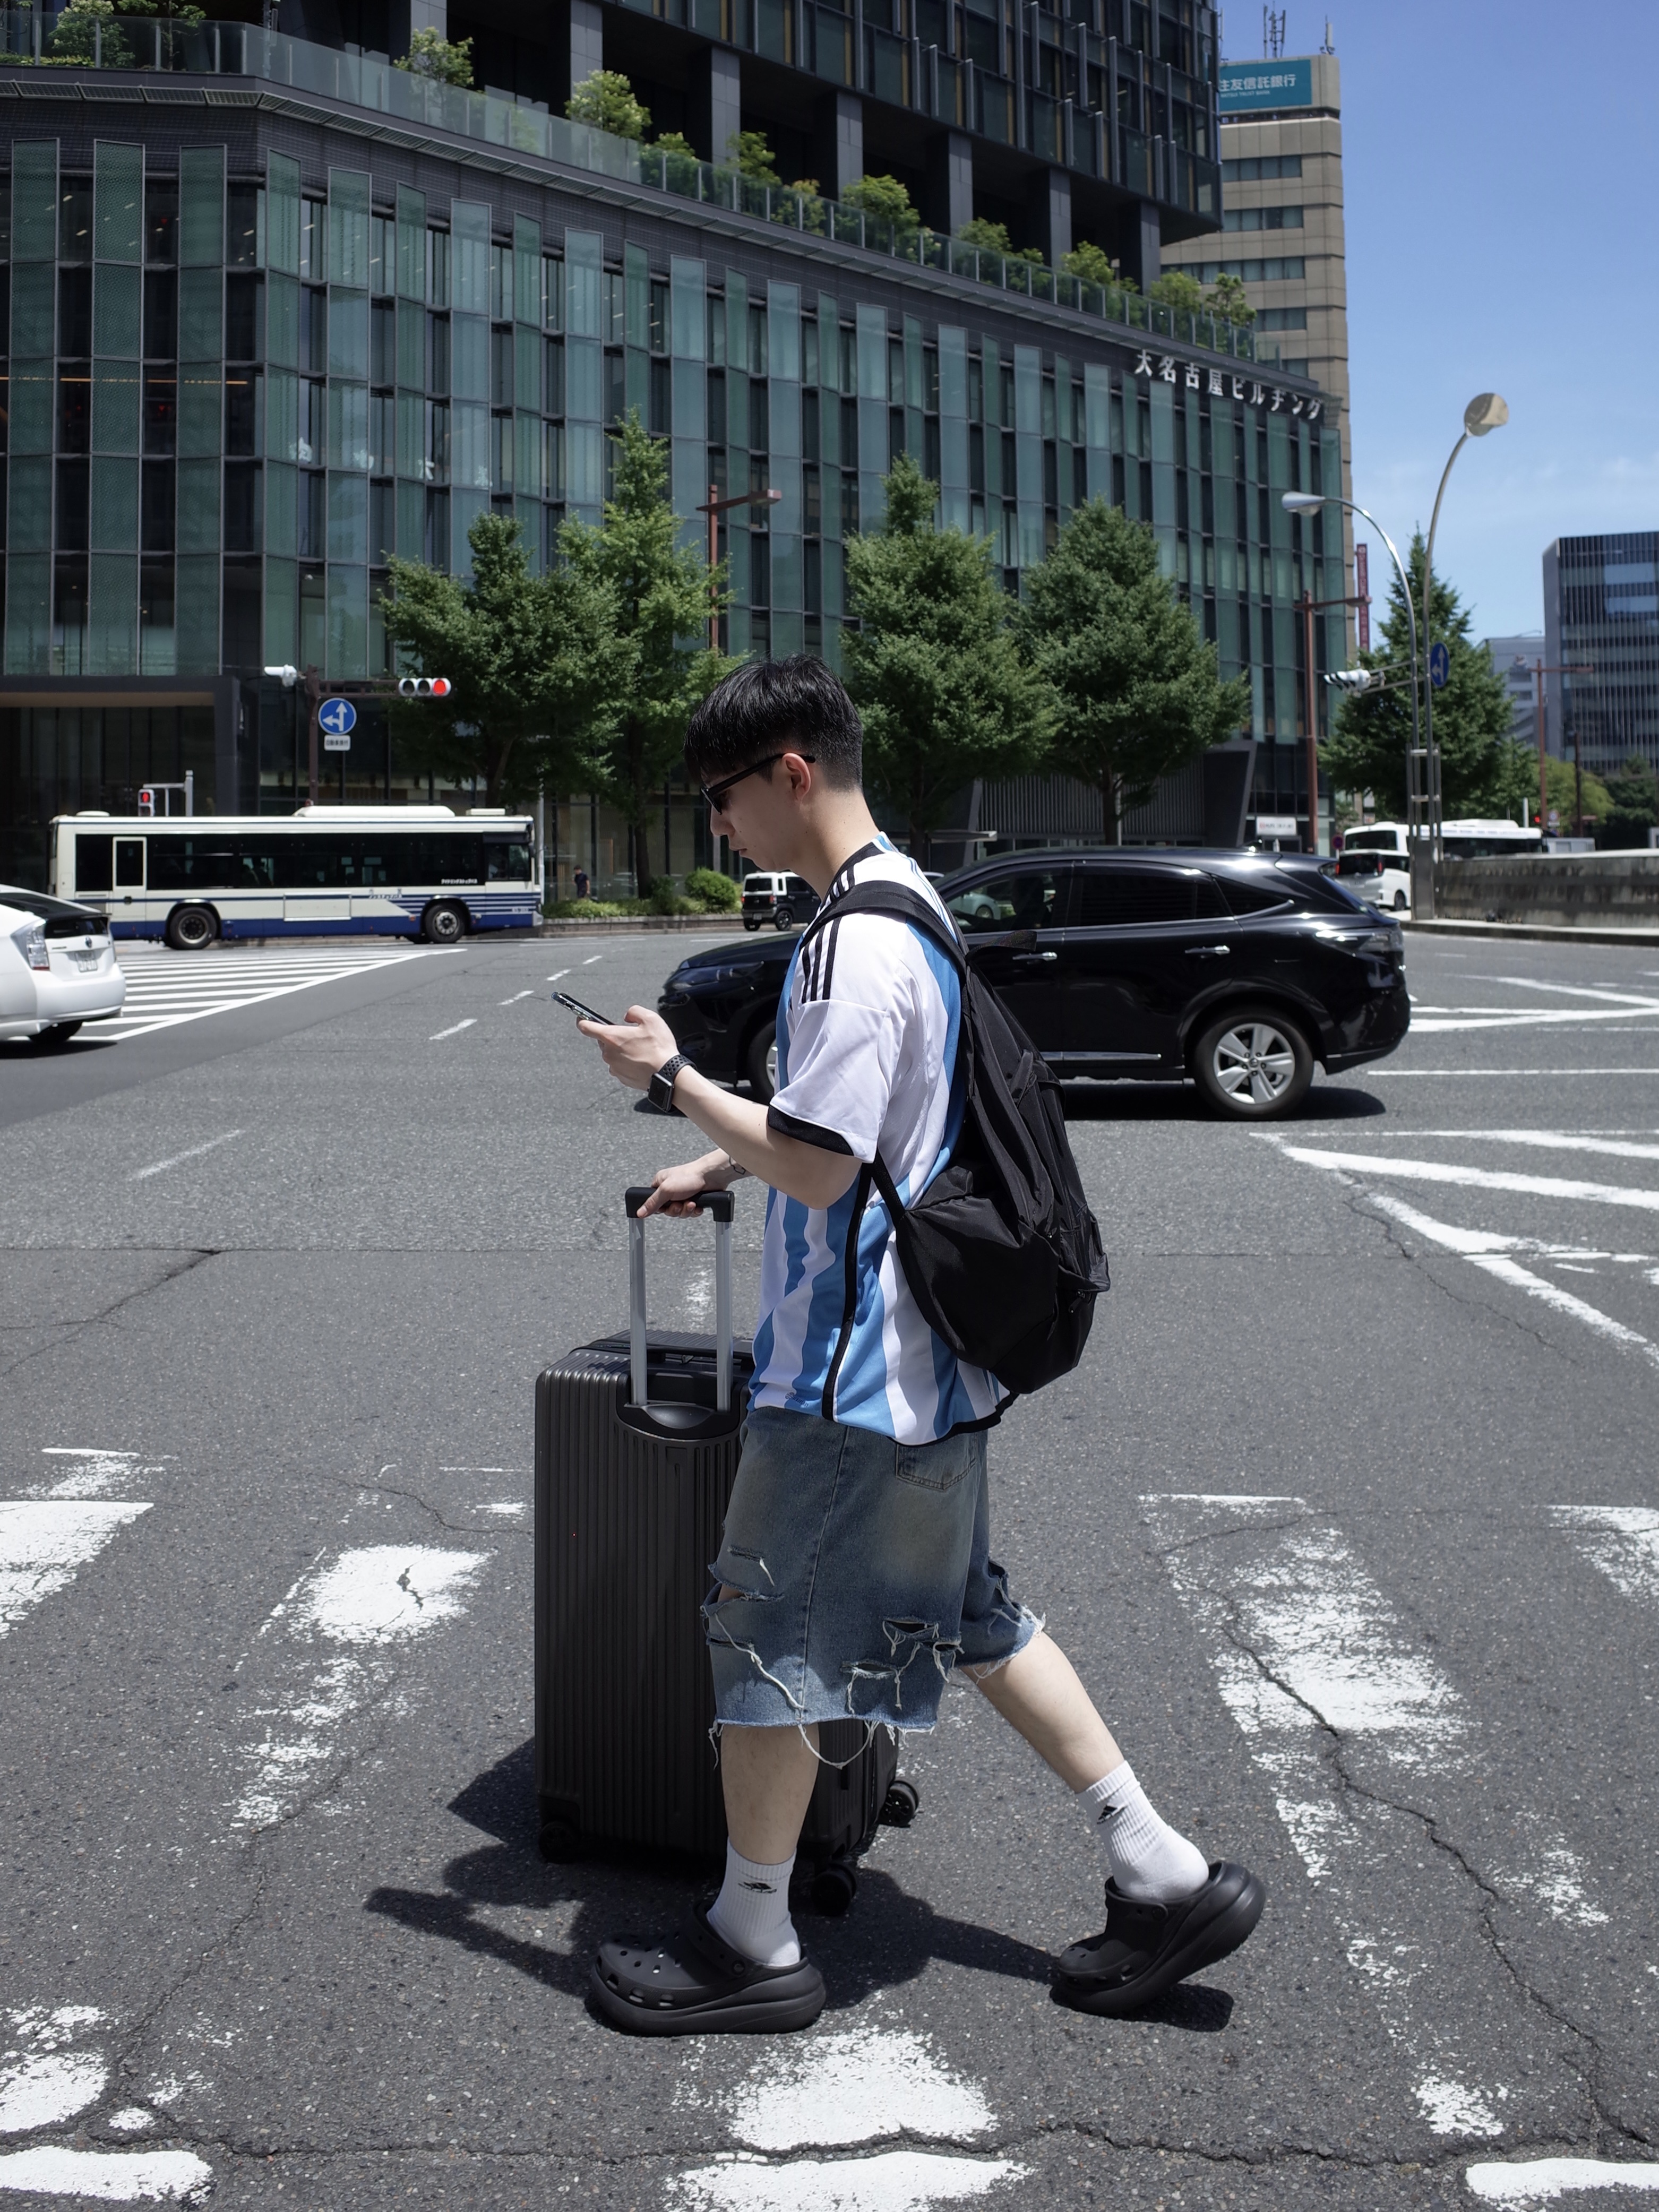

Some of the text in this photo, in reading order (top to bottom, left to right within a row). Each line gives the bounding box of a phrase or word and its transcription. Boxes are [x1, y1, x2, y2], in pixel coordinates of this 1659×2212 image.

[1134, 349, 1323, 419] 大名古屋ビルヂング
